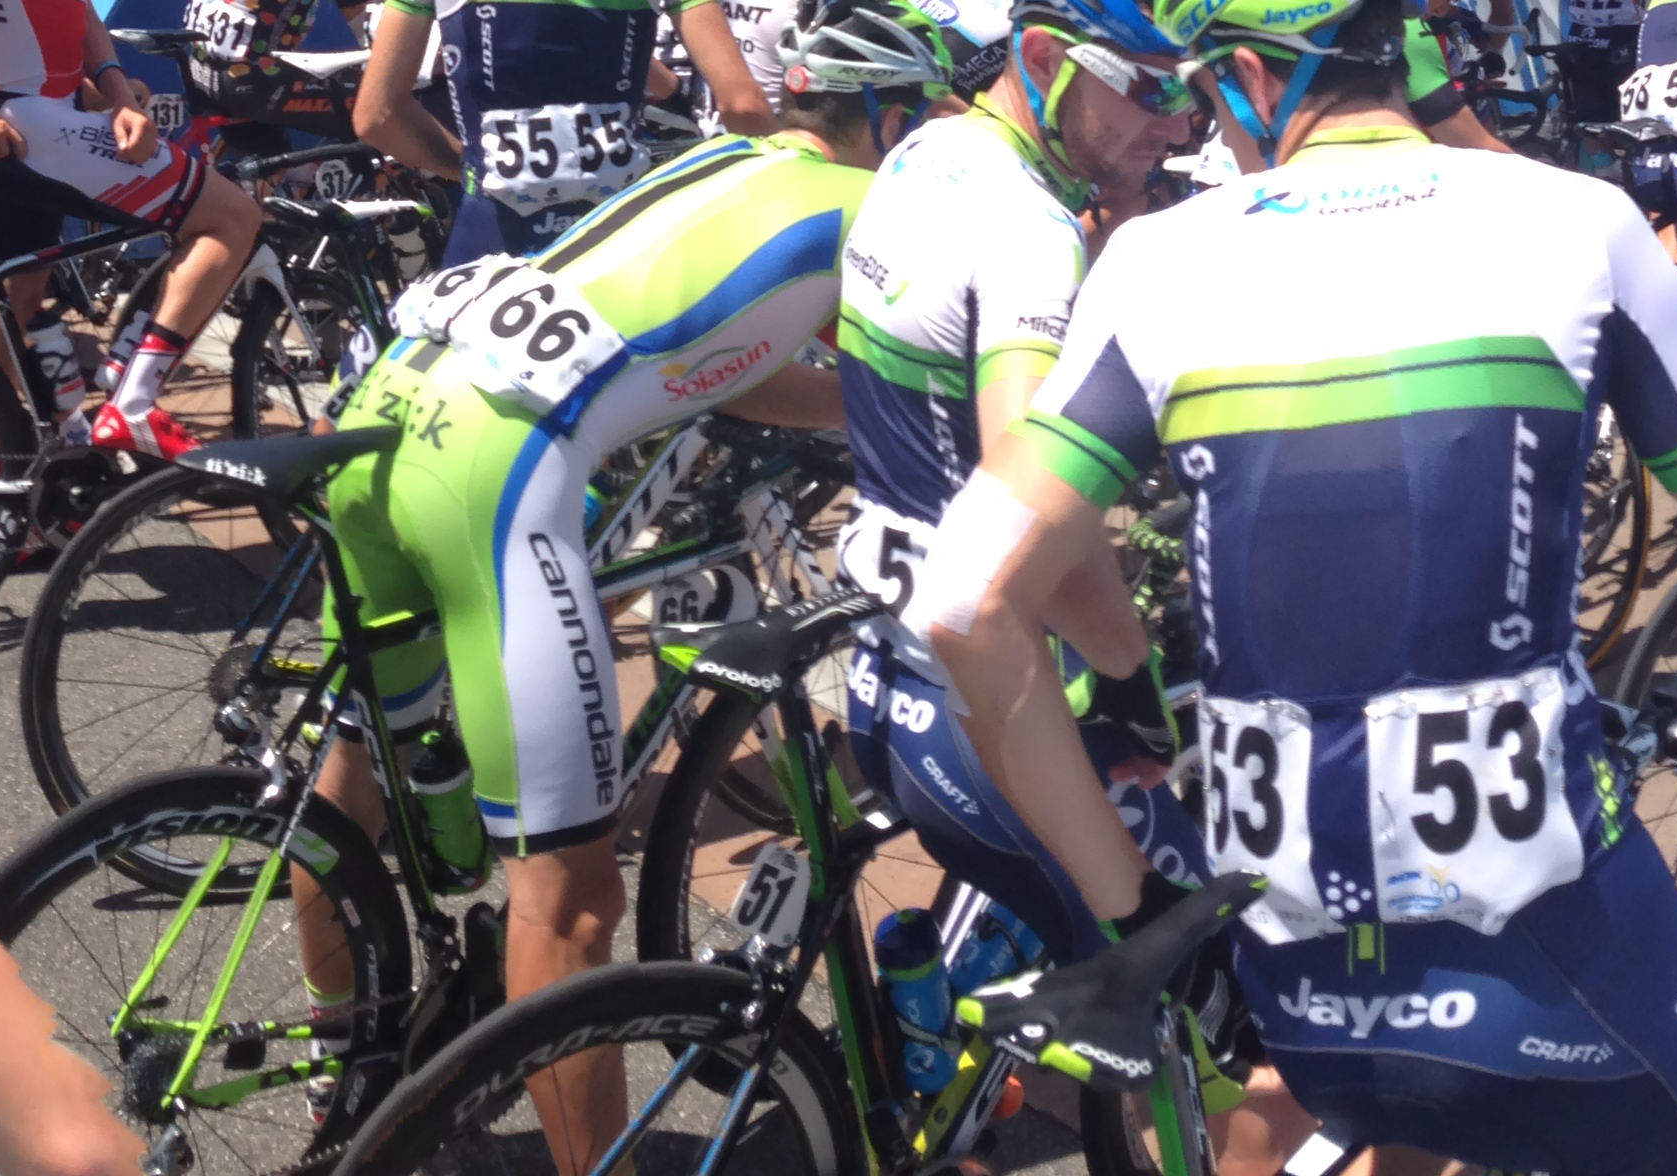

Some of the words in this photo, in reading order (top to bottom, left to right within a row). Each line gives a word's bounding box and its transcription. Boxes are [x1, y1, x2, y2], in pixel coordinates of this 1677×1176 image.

[1260, 1, 1332, 25] Jayco
[480, 22, 496, 92] SCOTT
[151, 102, 181, 126] 131
[495, 116, 558, 179] 55
[574, 110, 634, 173] 55
[490, 282, 591, 363] 66
[662, 339, 773, 403] Sojasun
[1507, 414, 1540, 606] SCOTT
[527, 530, 615, 808] cannondale
[1410, 699, 1548, 856] 53
[1278, 977, 1479, 1041] Jayco
[1519, 1036, 1592, 1066] CRAFT
